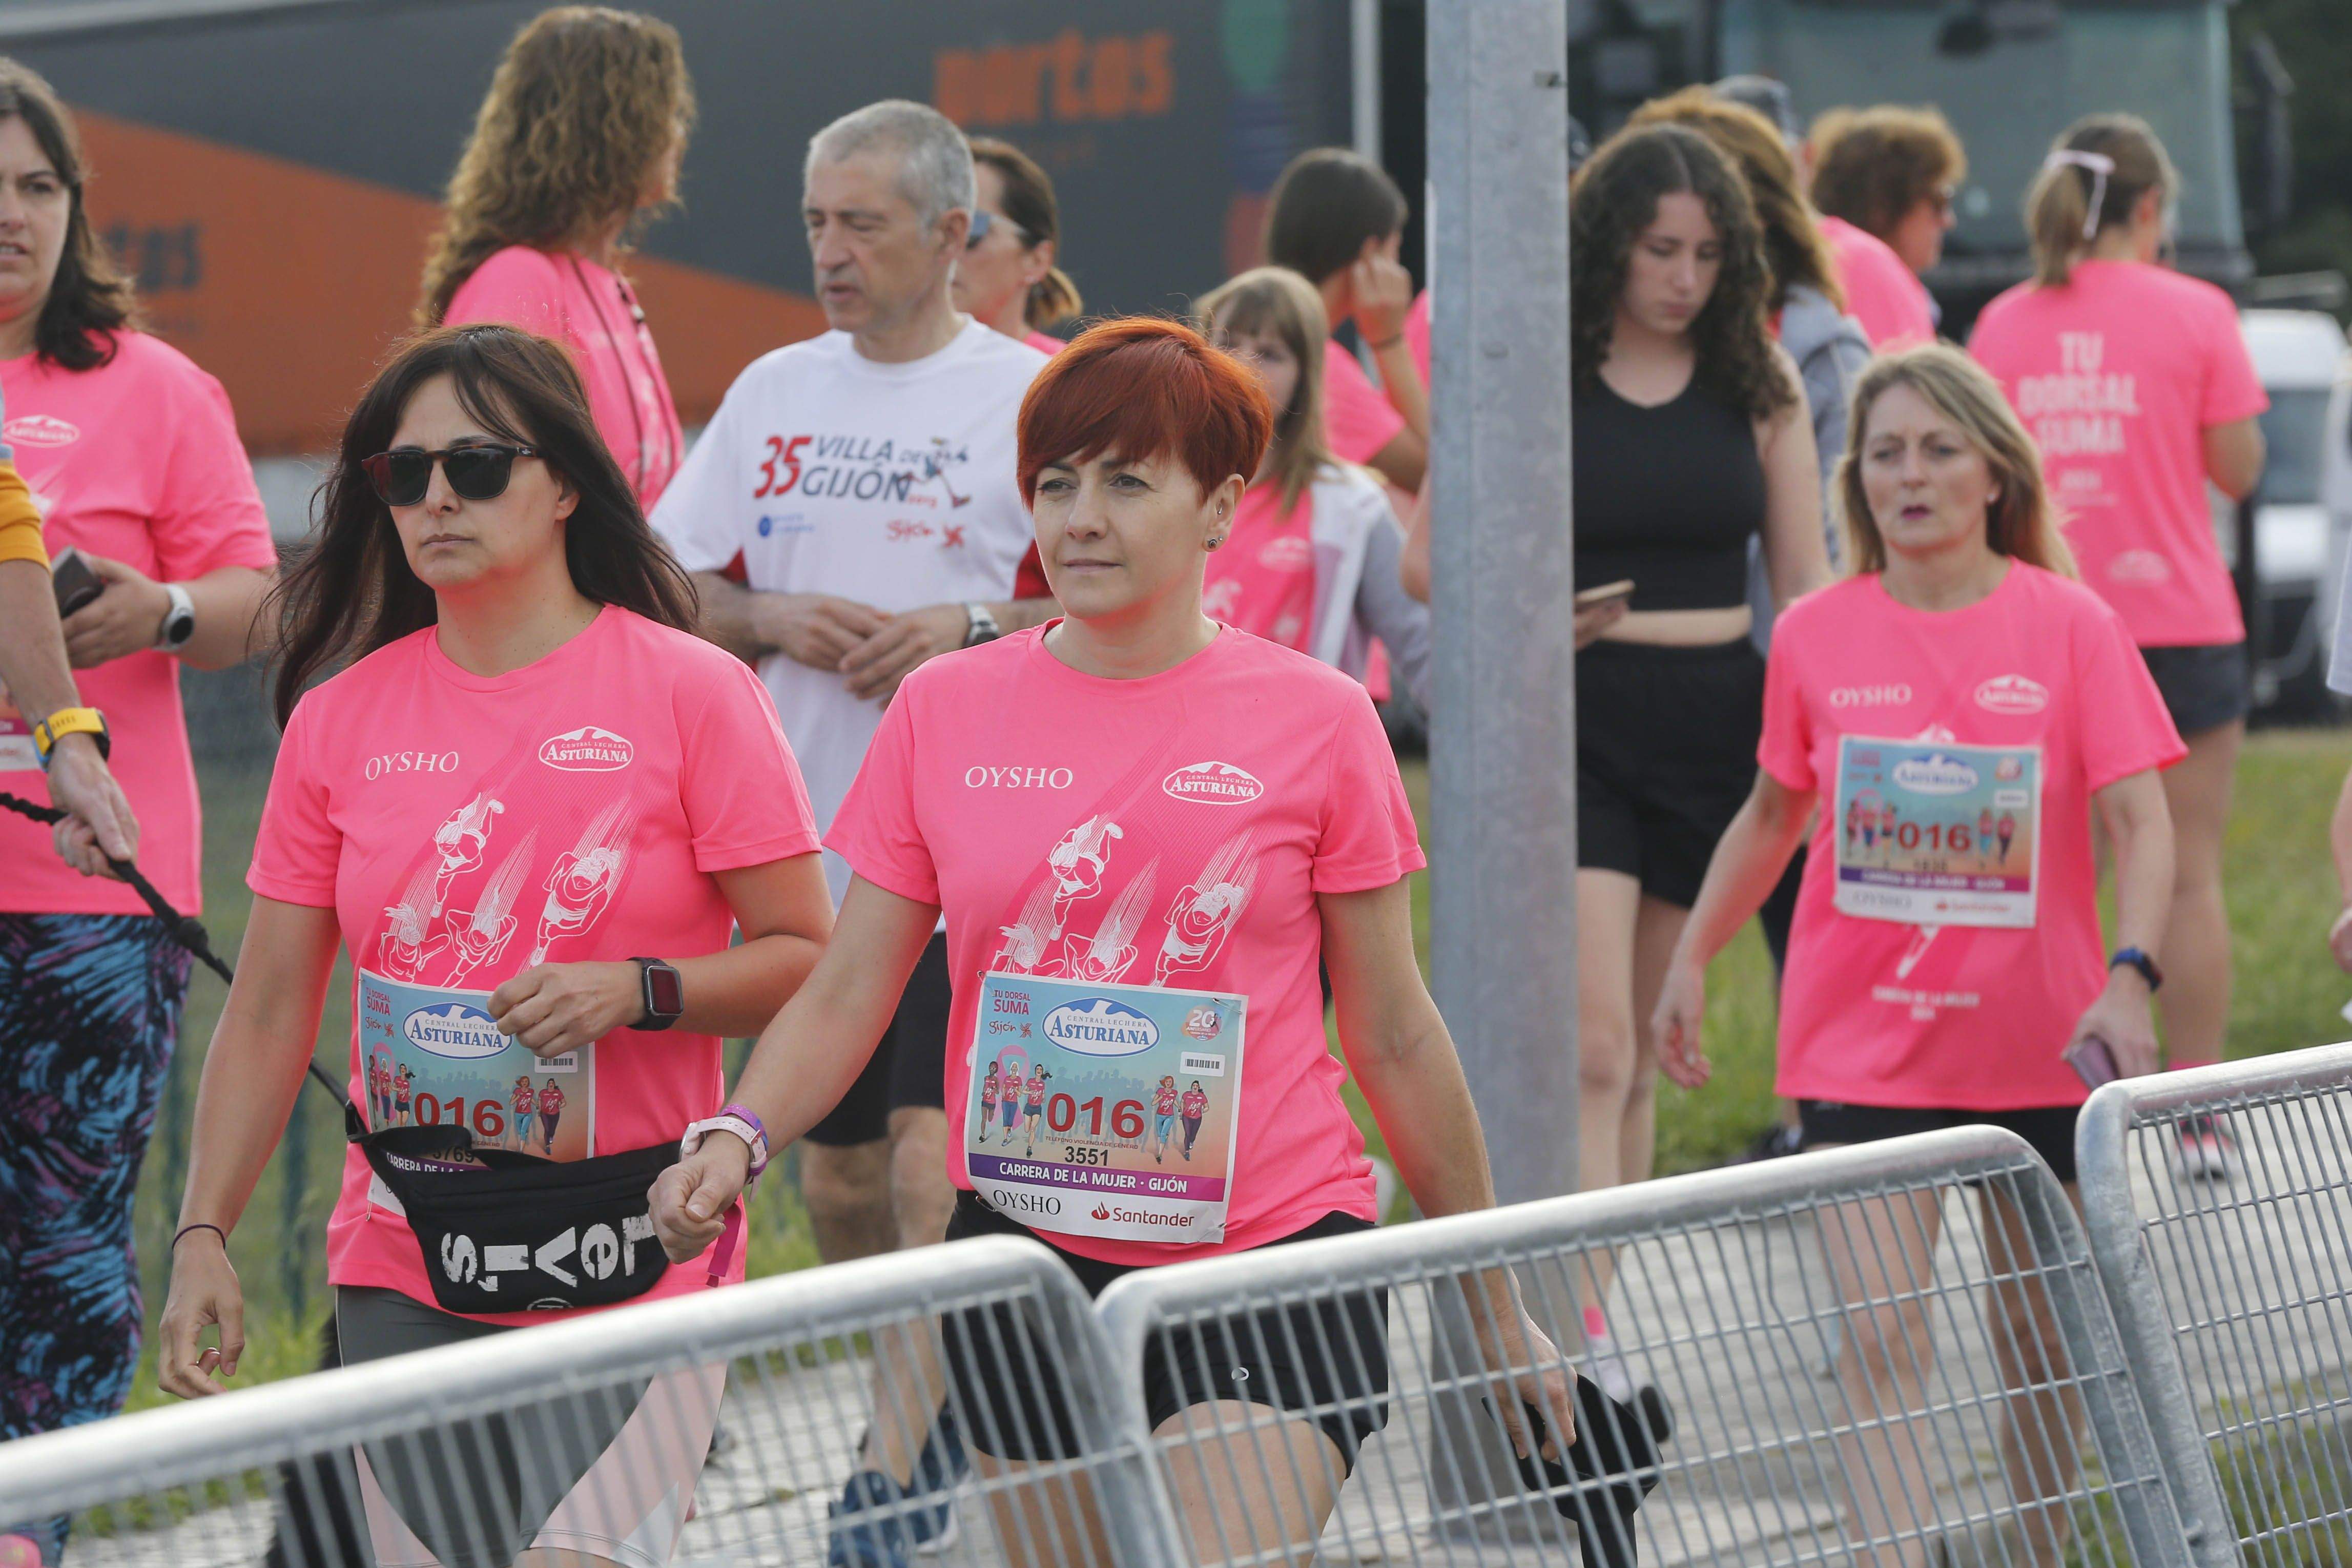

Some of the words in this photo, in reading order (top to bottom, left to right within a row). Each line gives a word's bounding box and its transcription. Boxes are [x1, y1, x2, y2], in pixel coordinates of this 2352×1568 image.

[2058, 332, 2104, 369] TU
[817, 436, 892, 461] VILLA
[2037, 418, 2126, 455] SUMA
[754, 436, 813, 499] 35
[801, 462, 912, 502] GIJÓN
[1830, 683, 1912, 708] OYSHO
[365, 751, 459, 780] OYSHO
[545, 744, 628, 762] ASTURIANA
[965, 767, 1073, 789] OYSHO
[1169, 776, 1255, 797] ASTURIANA
[1222, 777, 1253, 786] LECHERA
[1899, 821, 1971, 852] 016
[367, 996, 390, 1016] SUMA
[372, 989, 390, 1003] DORSAL
[994, 1000, 1029, 1015] SUMA
[1005, 992, 1031, 1001] DORSAL
[425, 1019, 460, 1028] CENTRAL
[1049, 1015, 1150, 1045] ASTURIANA
[1067, 1015, 1103, 1024] CENTRAL
[1108, 1019, 1147, 1028] LECHERA
[1189, 1009, 1215, 1028] 20
[410, 1019, 504, 1048] ASTURIANA
[415, 1092, 504, 1137] 016
[1047, 1093, 1144, 1139] 016
[1065, 1146, 1108, 1166] 3551
[999, 1162, 1050, 1180] CARRERA
[1054, 1168, 1068, 1183] DE
[1072, 1170, 1087, 1184] LA
[1092, 1172, 1136, 1189] MUJER
[1148, 1175, 1187, 1193] GIJÓN
[993, 1190, 1061, 1215] OYSHO
[1113, 1207, 1194, 1227] Santander
